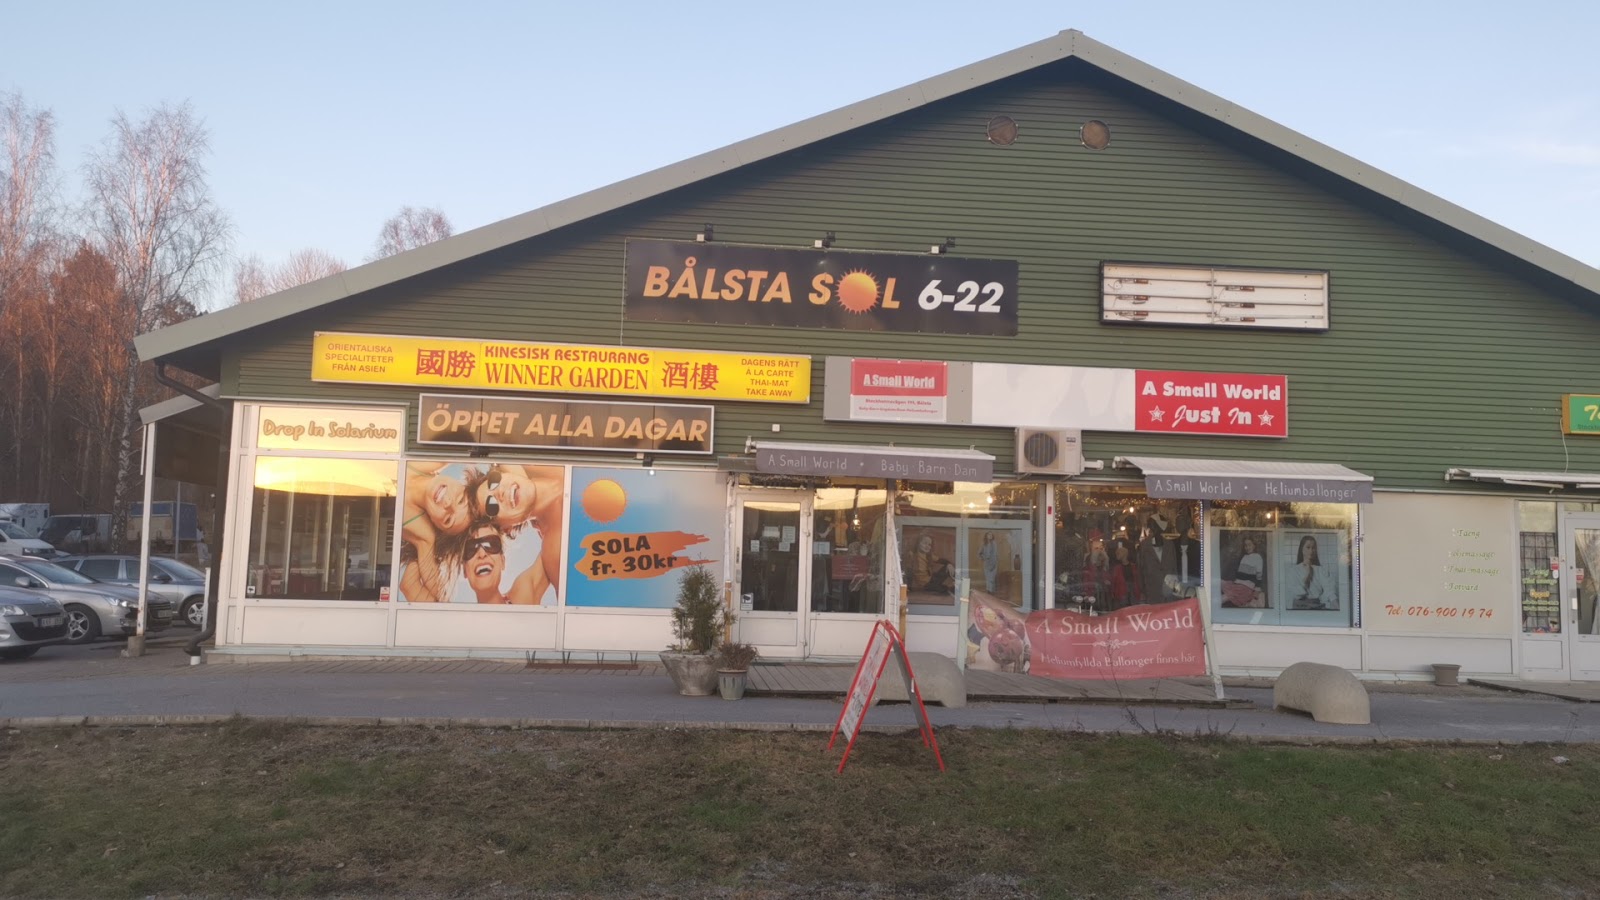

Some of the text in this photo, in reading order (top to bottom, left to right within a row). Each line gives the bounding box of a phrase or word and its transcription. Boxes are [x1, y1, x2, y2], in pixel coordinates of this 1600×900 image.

[643, 256, 792, 303] BÅLSTA
[918, 279, 1004, 313] 6-22
[328, 343, 392, 353] ORIENTALISKA
[485, 346, 650, 364] KINESISK RESTAURANG
[325, 353, 394, 363] SPECIALITETER
[416, 348, 476, 378] 國勝
[742, 358, 800, 368] DAGENS RÄTT
[332, 363, 386, 373] FRÅN ASIEN
[485, 362, 648, 390] WINNER GARDEN
[661, 361, 720, 390] 酒樓
[864, 374, 935, 389] A Small World
[1142, 381, 1280, 400] A Small World
[770, 389, 792, 397] AWAY
[427, 404, 708, 442] ÖPPET ALLA DAGAR
[1172, 404, 1252, 428] Just In
[263, 418, 397, 441] Drop In Solarium
[768, 454, 847, 470] A Small World
[881, 460, 976, 477] Baby Barn Dam
[1155, 480, 1232, 494] A Small World
[1266, 482, 1356, 500] Heliumballonger
[592, 535, 650, 556] SOLA
[590, 554, 678, 576] fr. 30kr
[1408, 606, 1458, 618] 076-900
[1462, 608, 1474, 618] 19
[1480, 608, 1493, 618] 74
[1034, 608, 1194, 635] A Small World
[1040, 652, 1196, 669] Heliumfyllda Ballonger finns här
